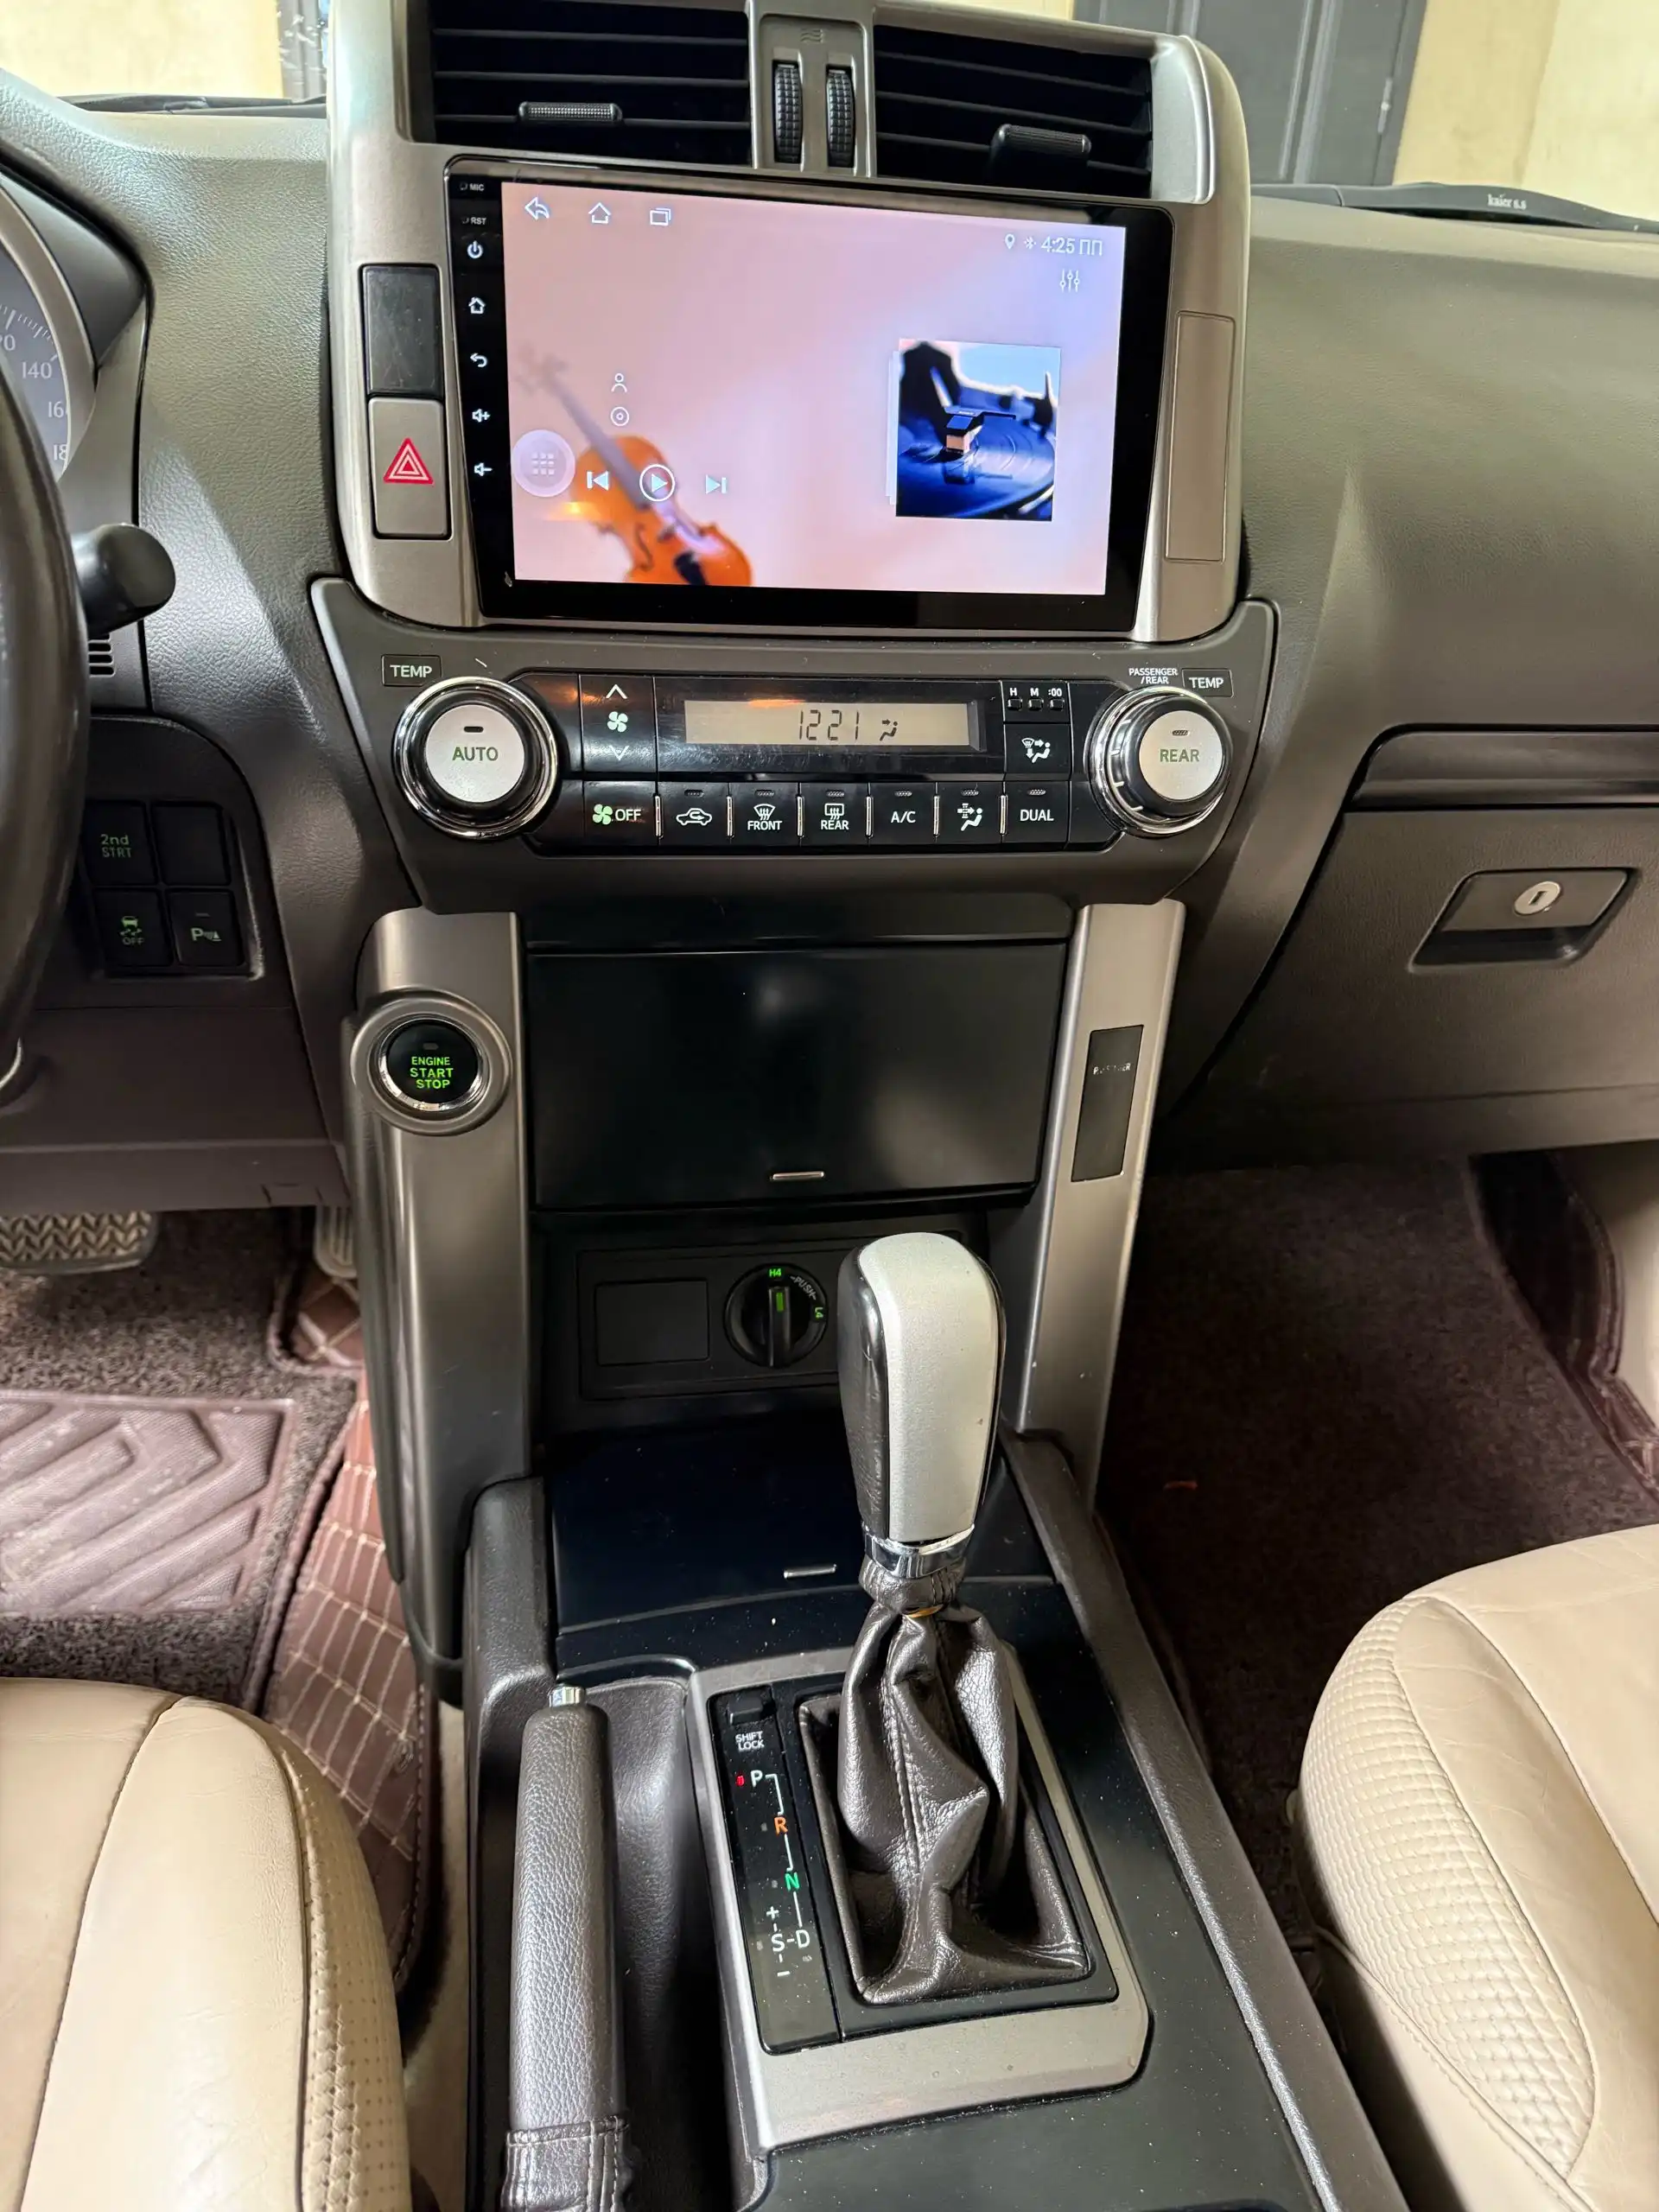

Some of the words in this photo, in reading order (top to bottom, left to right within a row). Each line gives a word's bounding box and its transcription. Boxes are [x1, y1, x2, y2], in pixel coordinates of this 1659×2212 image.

[1041, 236, 1075, 254] 4:25
[22, 361, 53, 379] 140
[48, 401, 67, 418] 16
[390, 664, 432, 678] TEMP
[1128, 668, 1179, 677] PASSENGER
[1141, 676, 1169, 684] /REAR
[1189, 677, 1224, 689] TEMP
[1009, 687, 1018, 696] H
[1030, 687, 1039, 697] M
[1048, 688, 1063, 697] :00
[452, 747, 499, 761] AUTO
[1160, 748, 1199, 762] REAR
[614, 809, 641, 822] OFF
[891, 810, 916, 823] A/C
[1020, 809, 1054, 822] DUAL
[747, 821, 782, 830] FRONT
[821, 820, 849, 830] REAR
[100, 833, 130, 845] 2nd
[102, 847, 131, 858] STRT
[122, 937, 144, 945] OFF
[411, 1056, 451, 1065] ENGINE
[410, 1067, 454, 1078] START
[416, 1078, 450, 1089] STOP
[769, 1268, 782, 1277] H4
[814, 1306, 823, 1319] L4
[735, 1731, 763, 1744] SHIFT
[738, 1740, 765, 1752] LOCK
[750, 1770, 763, 1788] P
[774, 1816, 788, 1835] R
[785, 1872, 799, 1891] N
